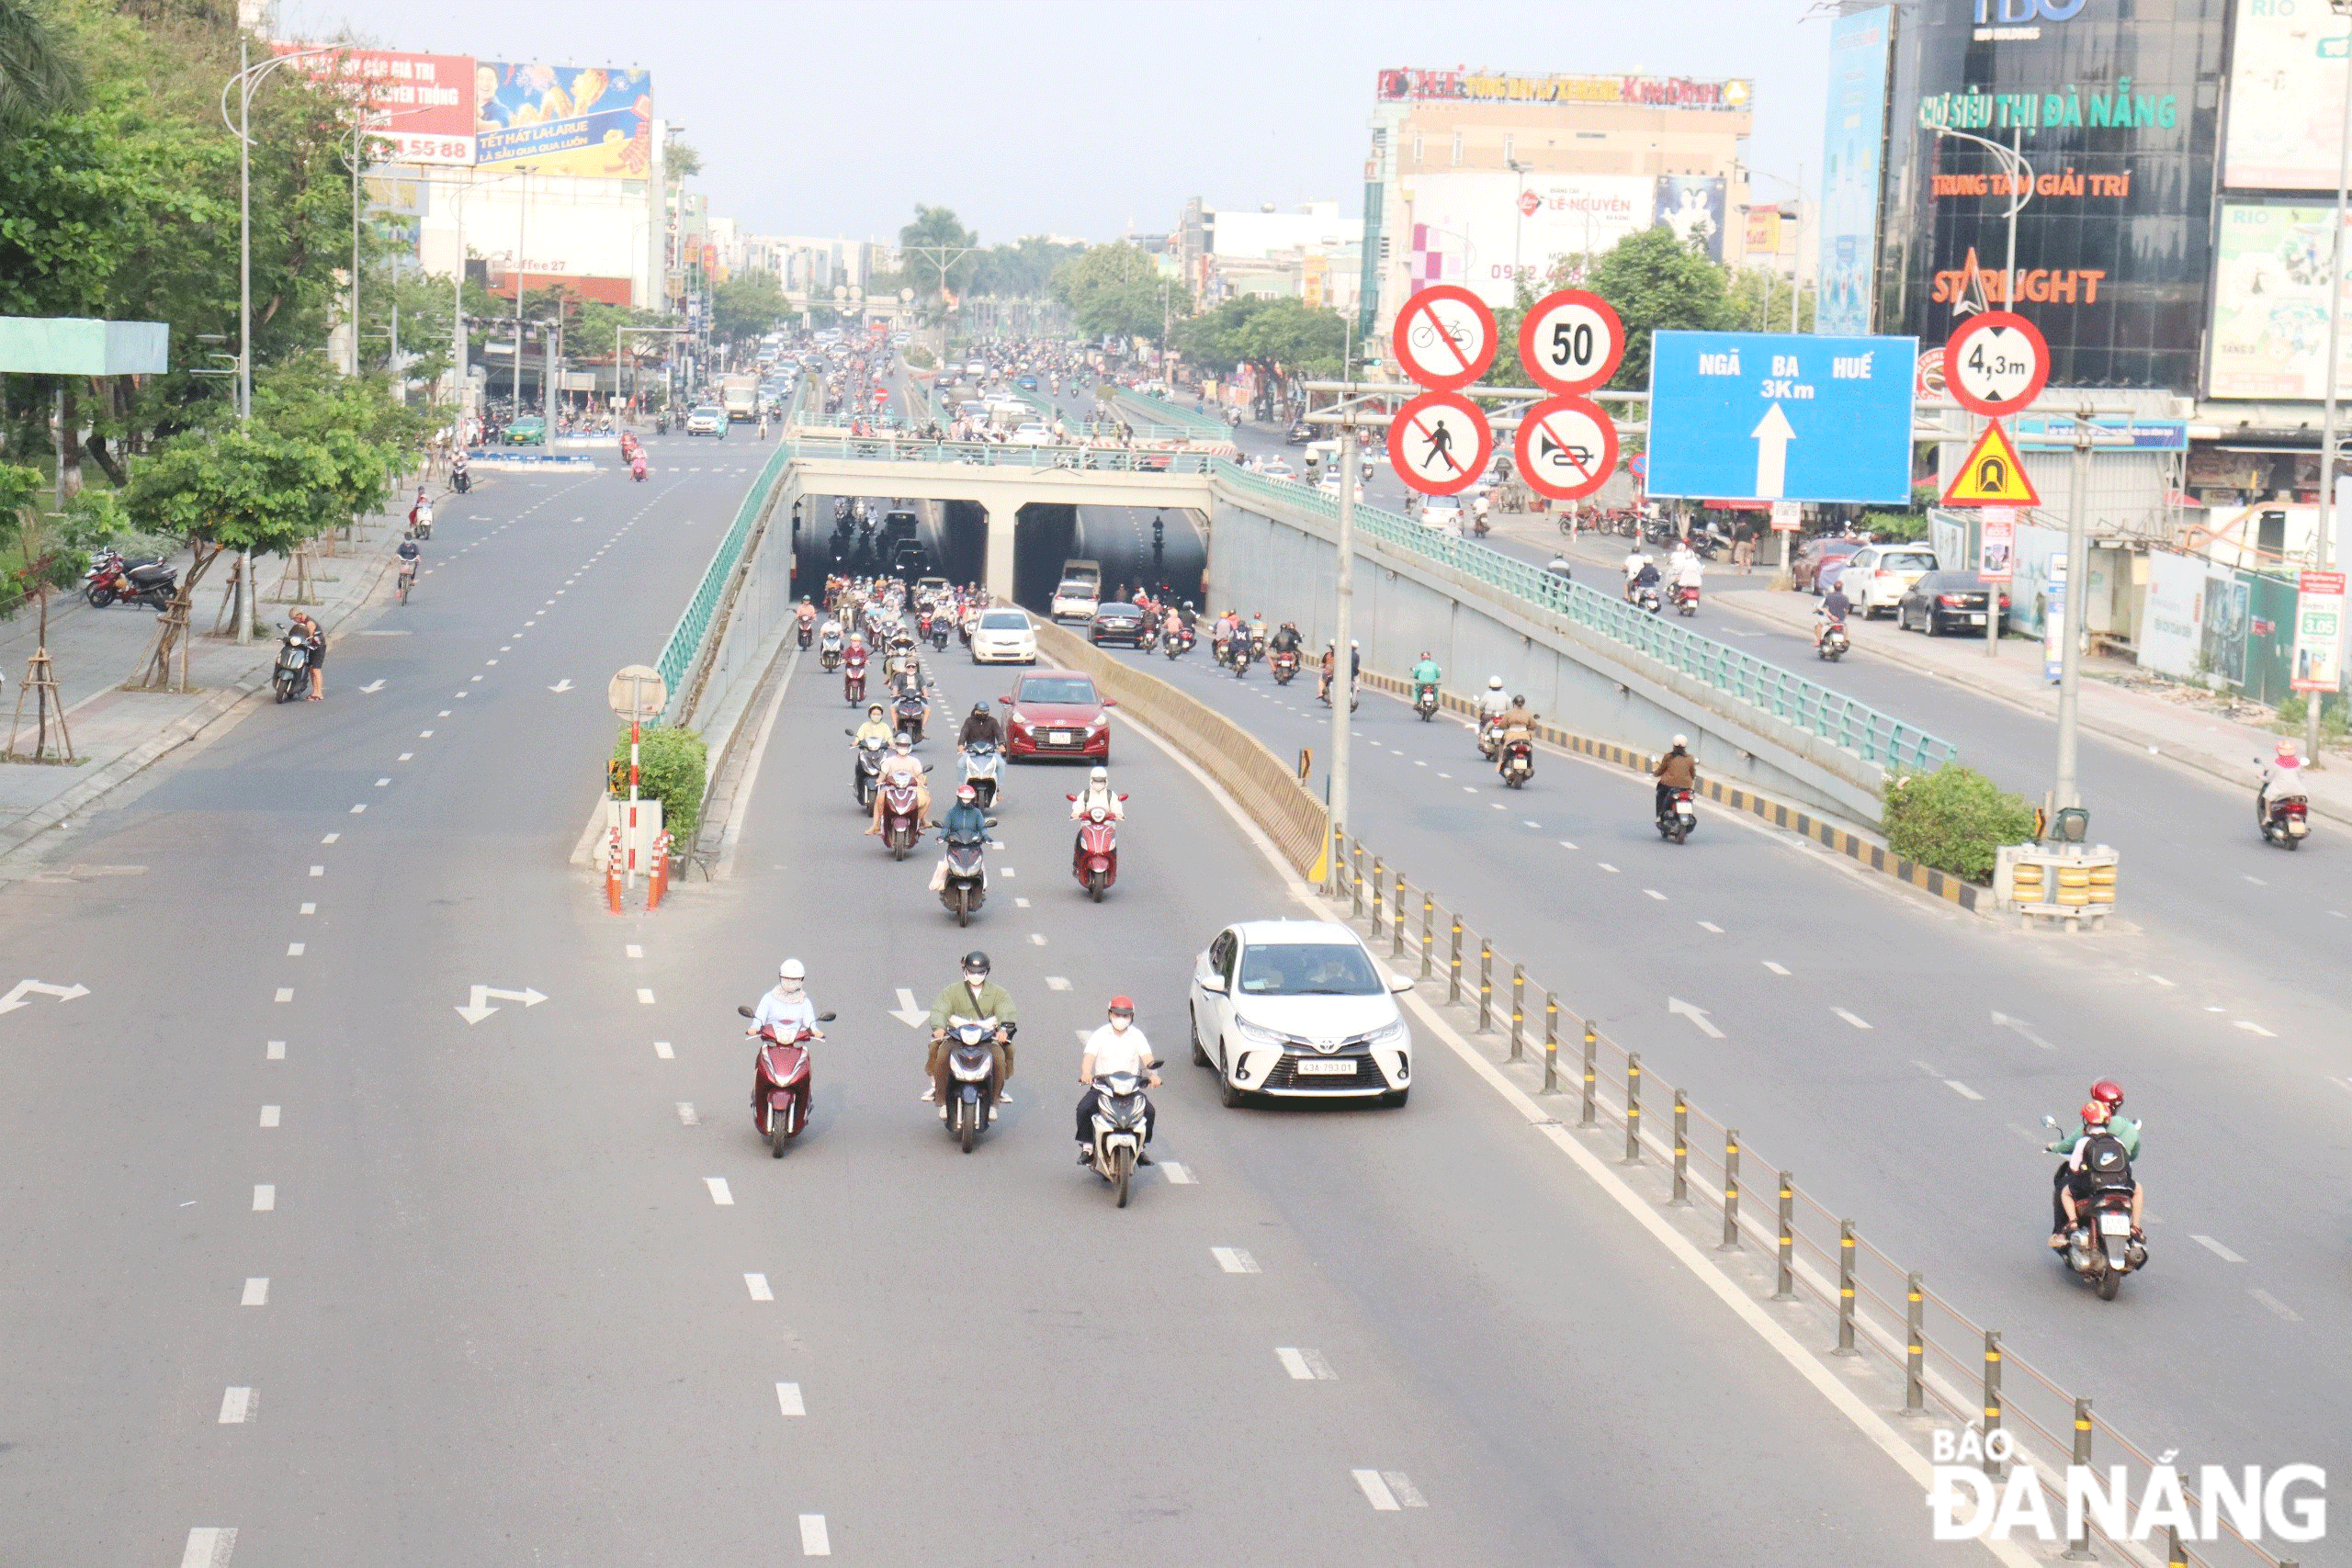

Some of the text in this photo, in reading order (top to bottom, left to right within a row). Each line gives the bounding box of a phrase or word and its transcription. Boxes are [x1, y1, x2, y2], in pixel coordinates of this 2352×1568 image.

[391, 59, 413, 79] GIÁ
[414, 62, 435, 83] TRỊ
[417, 82, 458, 106] THỐNG
[1949, 85, 1993, 129] SIÊU
[1996, 94, 2039, 137] THỊ
[2042, 84, 2083, 129] ĐÀ
[2089, 76, 2176, 129] NẴNG
[410, 140, 435, 157] 55
[440, 142, 467, 159] 88
[480, 131, 504, 149] TẾT
[505, 130, 531, 144] HÁT
[480, 150, 492, 162] LÀ
[516, 145, 537, 156] QUA
[538, 141, 560, 152] QUA
[1931, 175, 1987, 196] TRUNG
[2036, 166, 2086, 196] GIẢI
[2088, 169, 2132, 196] TRÍ
[1549, 195, 1566, 210] LÊ
[2233, 209, 2268, 224] RIO
[550, 261, 566, 272] 27
[1552, 323, 1593, 367] 50
[1699, 349, 1876, 379] NGÃ BA HUẾ
[1968, 344, 2026, 381] 4,3m
[1759, 378, 1815, 400] 3Km
